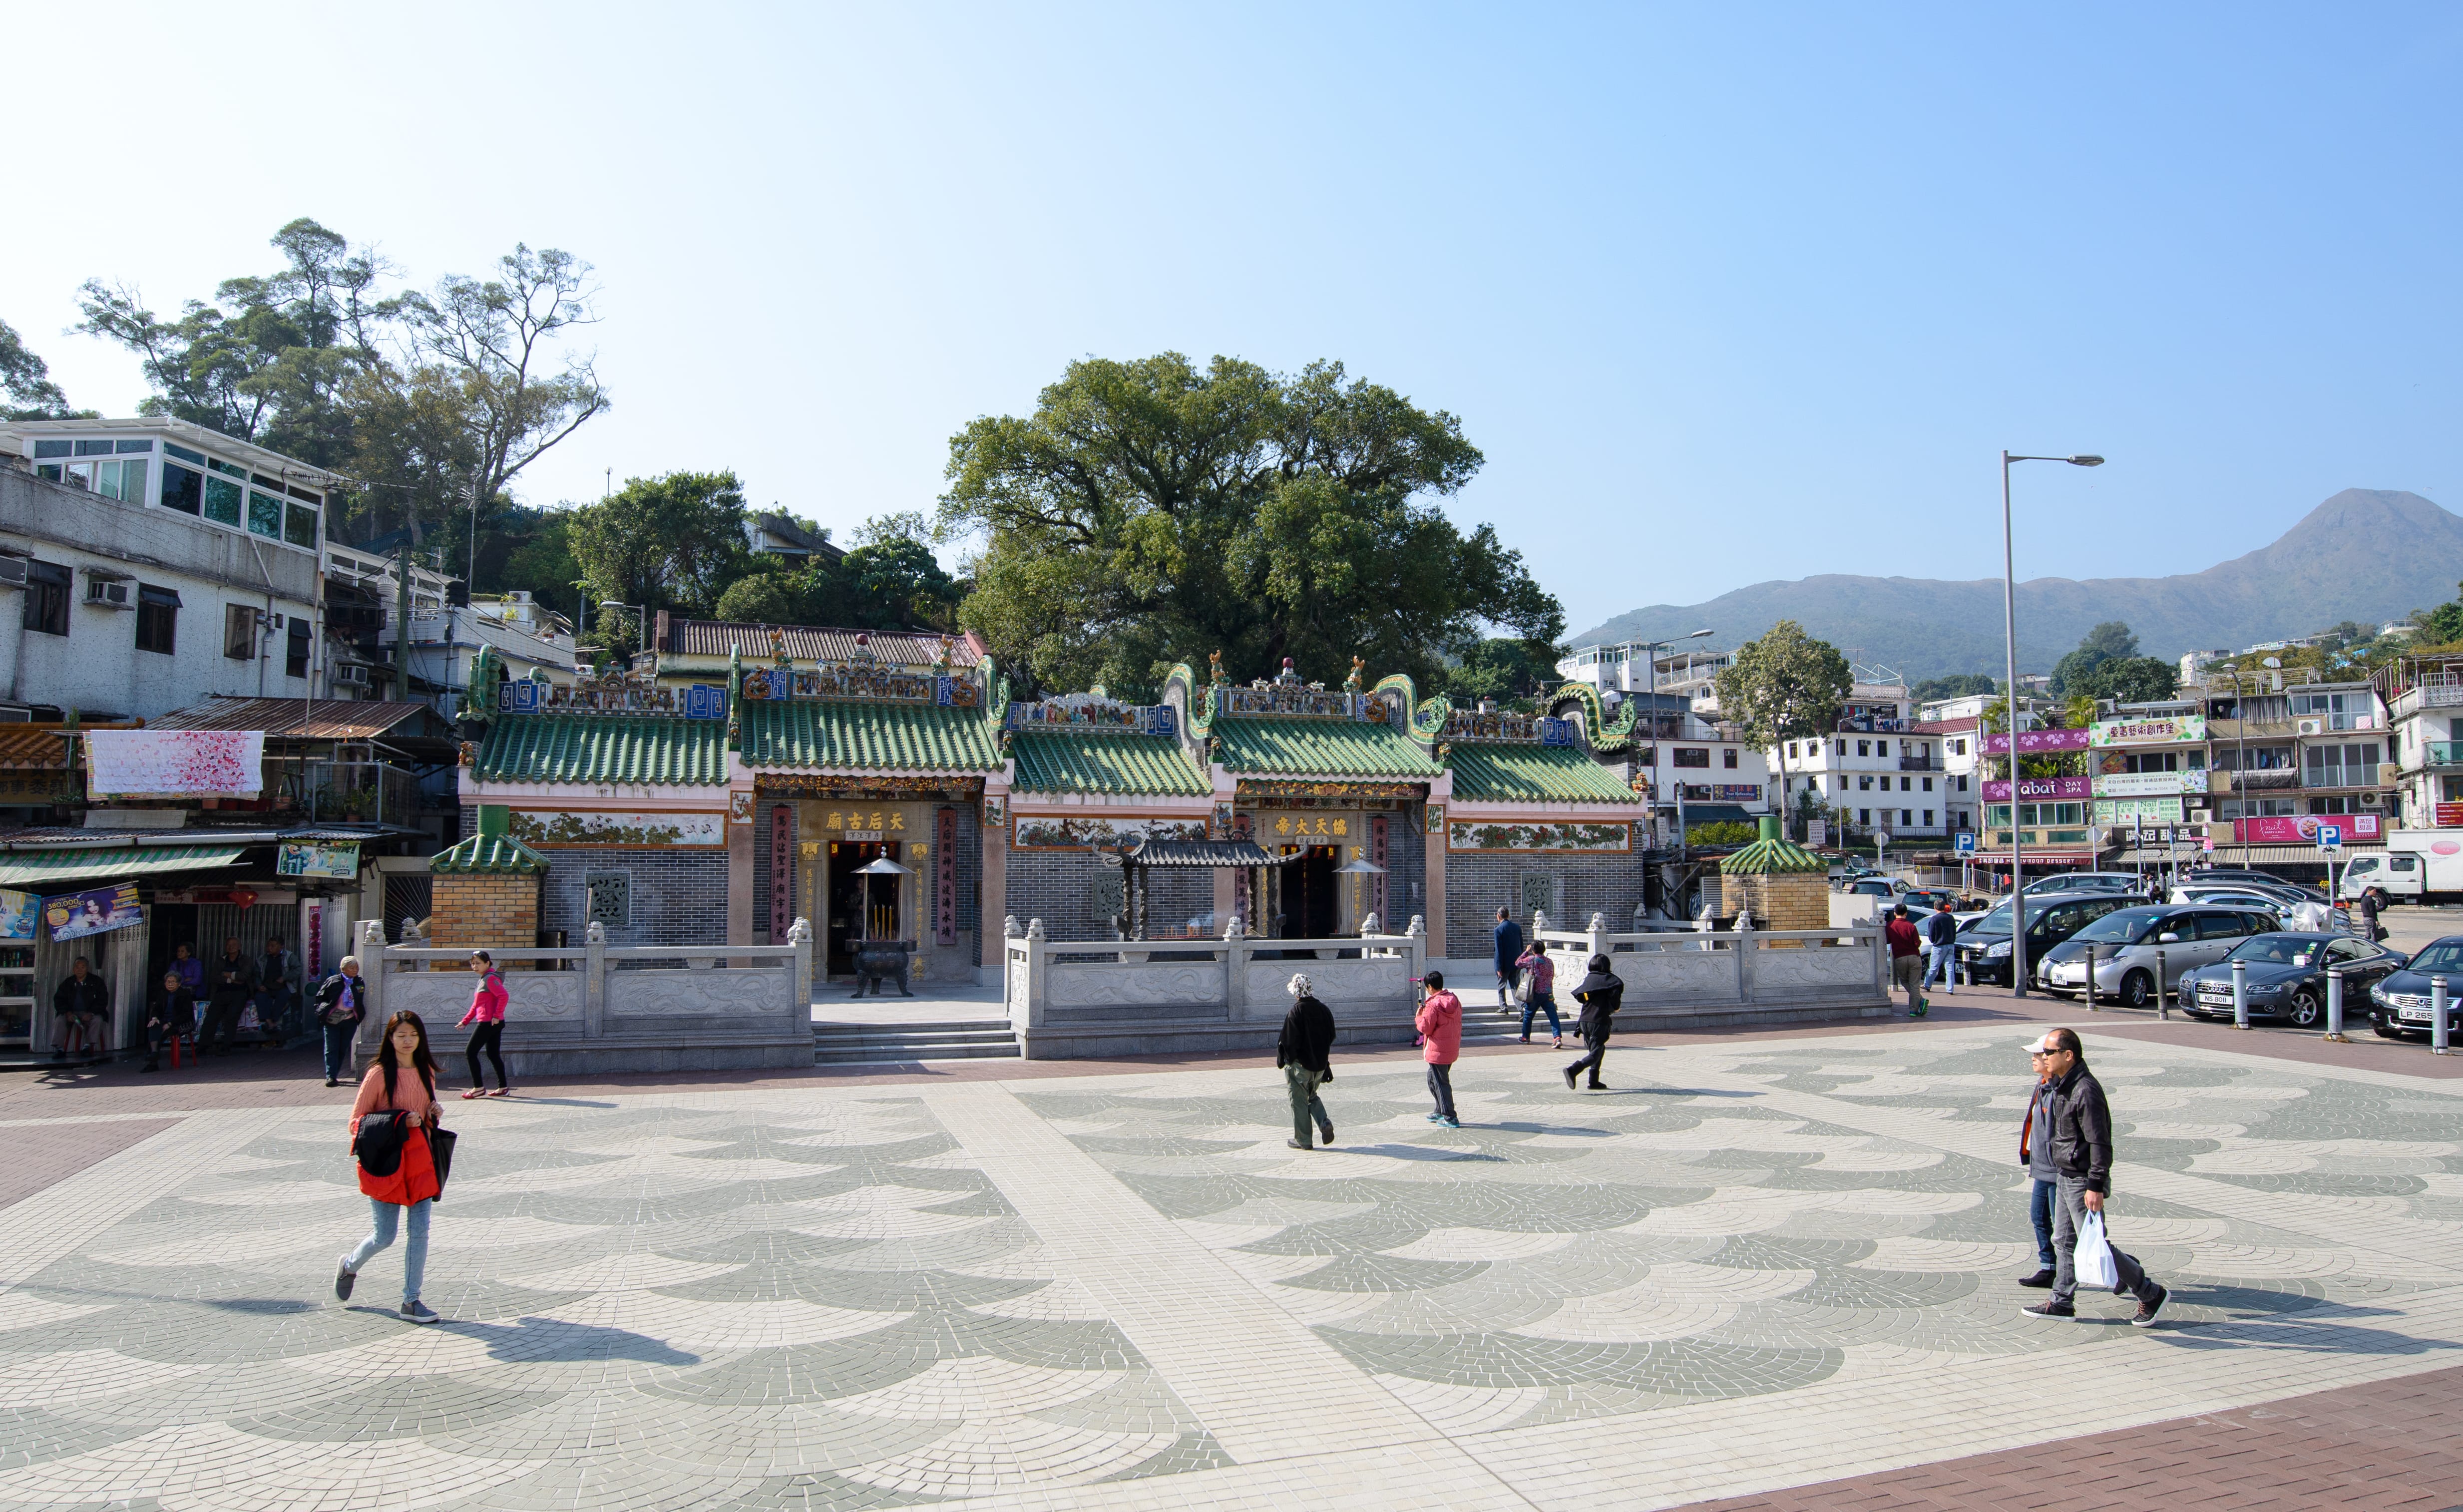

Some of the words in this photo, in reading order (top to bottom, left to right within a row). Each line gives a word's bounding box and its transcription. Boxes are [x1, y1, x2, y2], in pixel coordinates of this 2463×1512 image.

[2019, 781, 2056, 795] abai
[826, 811, 905, 830] 天后古廟
[1275, 816, 1347, 836] 協天大帝
[1959, 834, 1972, 849] P
[2321, 827, 2337, 844] P
[48, 898, 78, 910] 380,000
